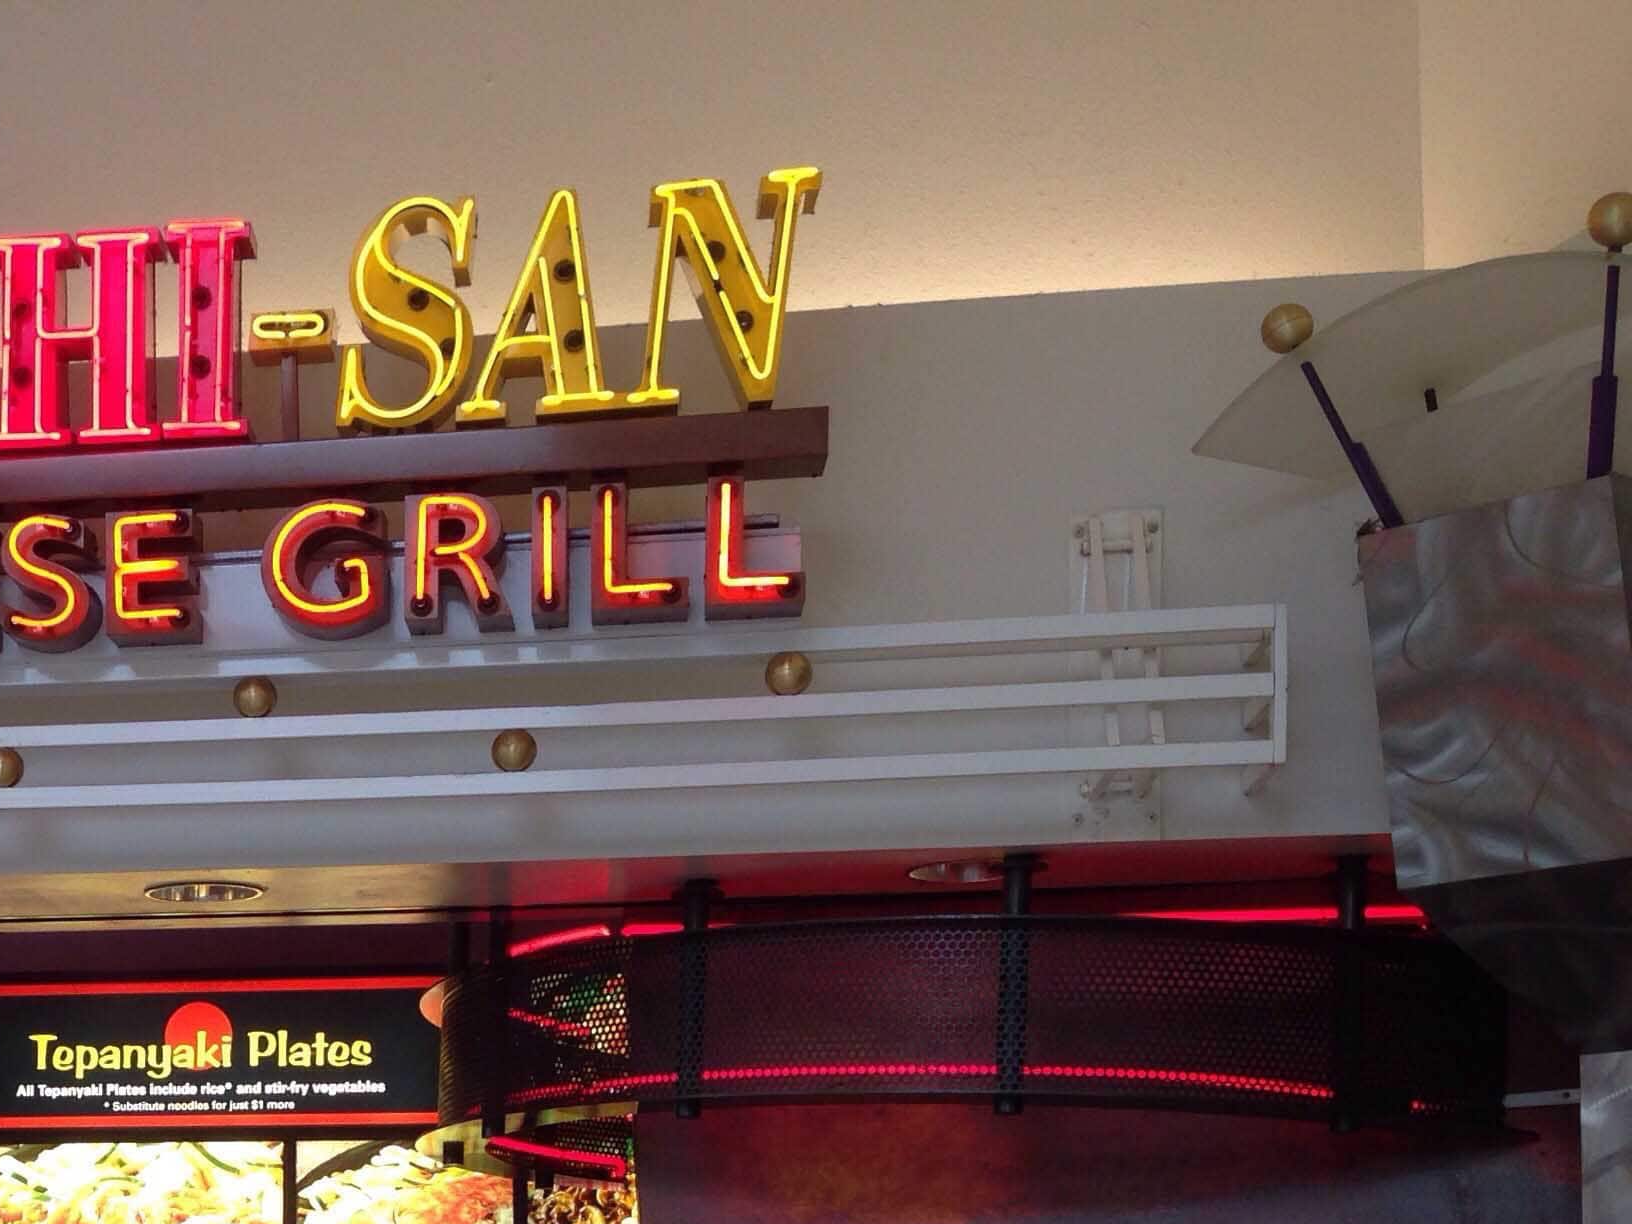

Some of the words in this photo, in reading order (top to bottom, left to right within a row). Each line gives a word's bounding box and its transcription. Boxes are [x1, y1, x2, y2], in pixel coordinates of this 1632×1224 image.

[262, 475, 804, 639] GRILL
[28, 1031, 232, 1079] Tepanyaki
[247, 1030, 373, 1068] Plates
[16, 1084, 34, 1098] All
[37, 1083, 104, 1099] Tepanyaki
[106, 1083, 147, 1096] Plates
[149, 1083, 198, 1096] include
[236, 1082, 262, 1095] and
[264, 1081, 310, 1097] stir-fry
[312, 1081, 386, 1096] vegetables
[112, 1100, 166, 1111] Substitute
[167, 1100, 210, 1111] noodles
[212, 1100, 227, 1110] for
[229, 1100, 249, 1112] just
[251, 1099, 264, 1110] $1
[267, 1101, 295, 1110] more
